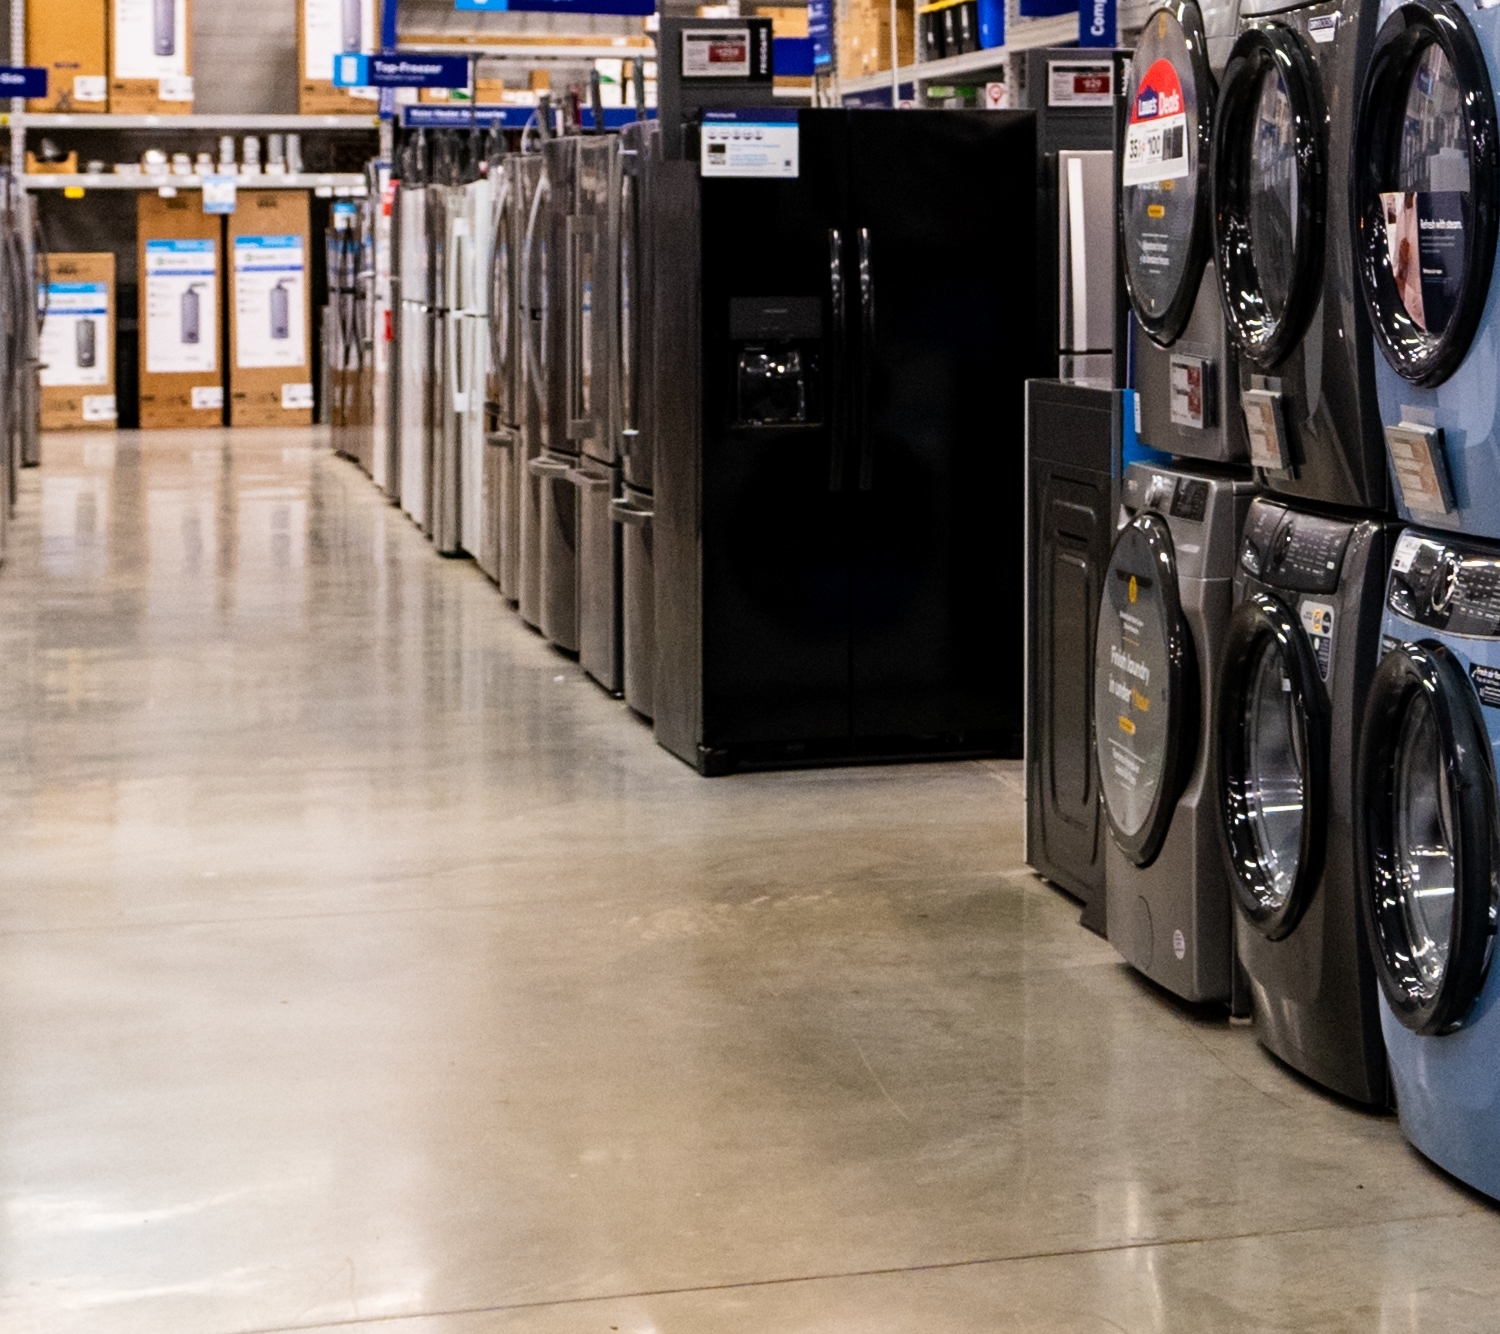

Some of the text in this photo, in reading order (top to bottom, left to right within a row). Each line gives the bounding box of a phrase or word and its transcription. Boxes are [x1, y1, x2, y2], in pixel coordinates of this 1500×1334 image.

[373, 60, 443, 75] Top-Freezer
[1138, 89, 1180, 117] Lowe's Deals
